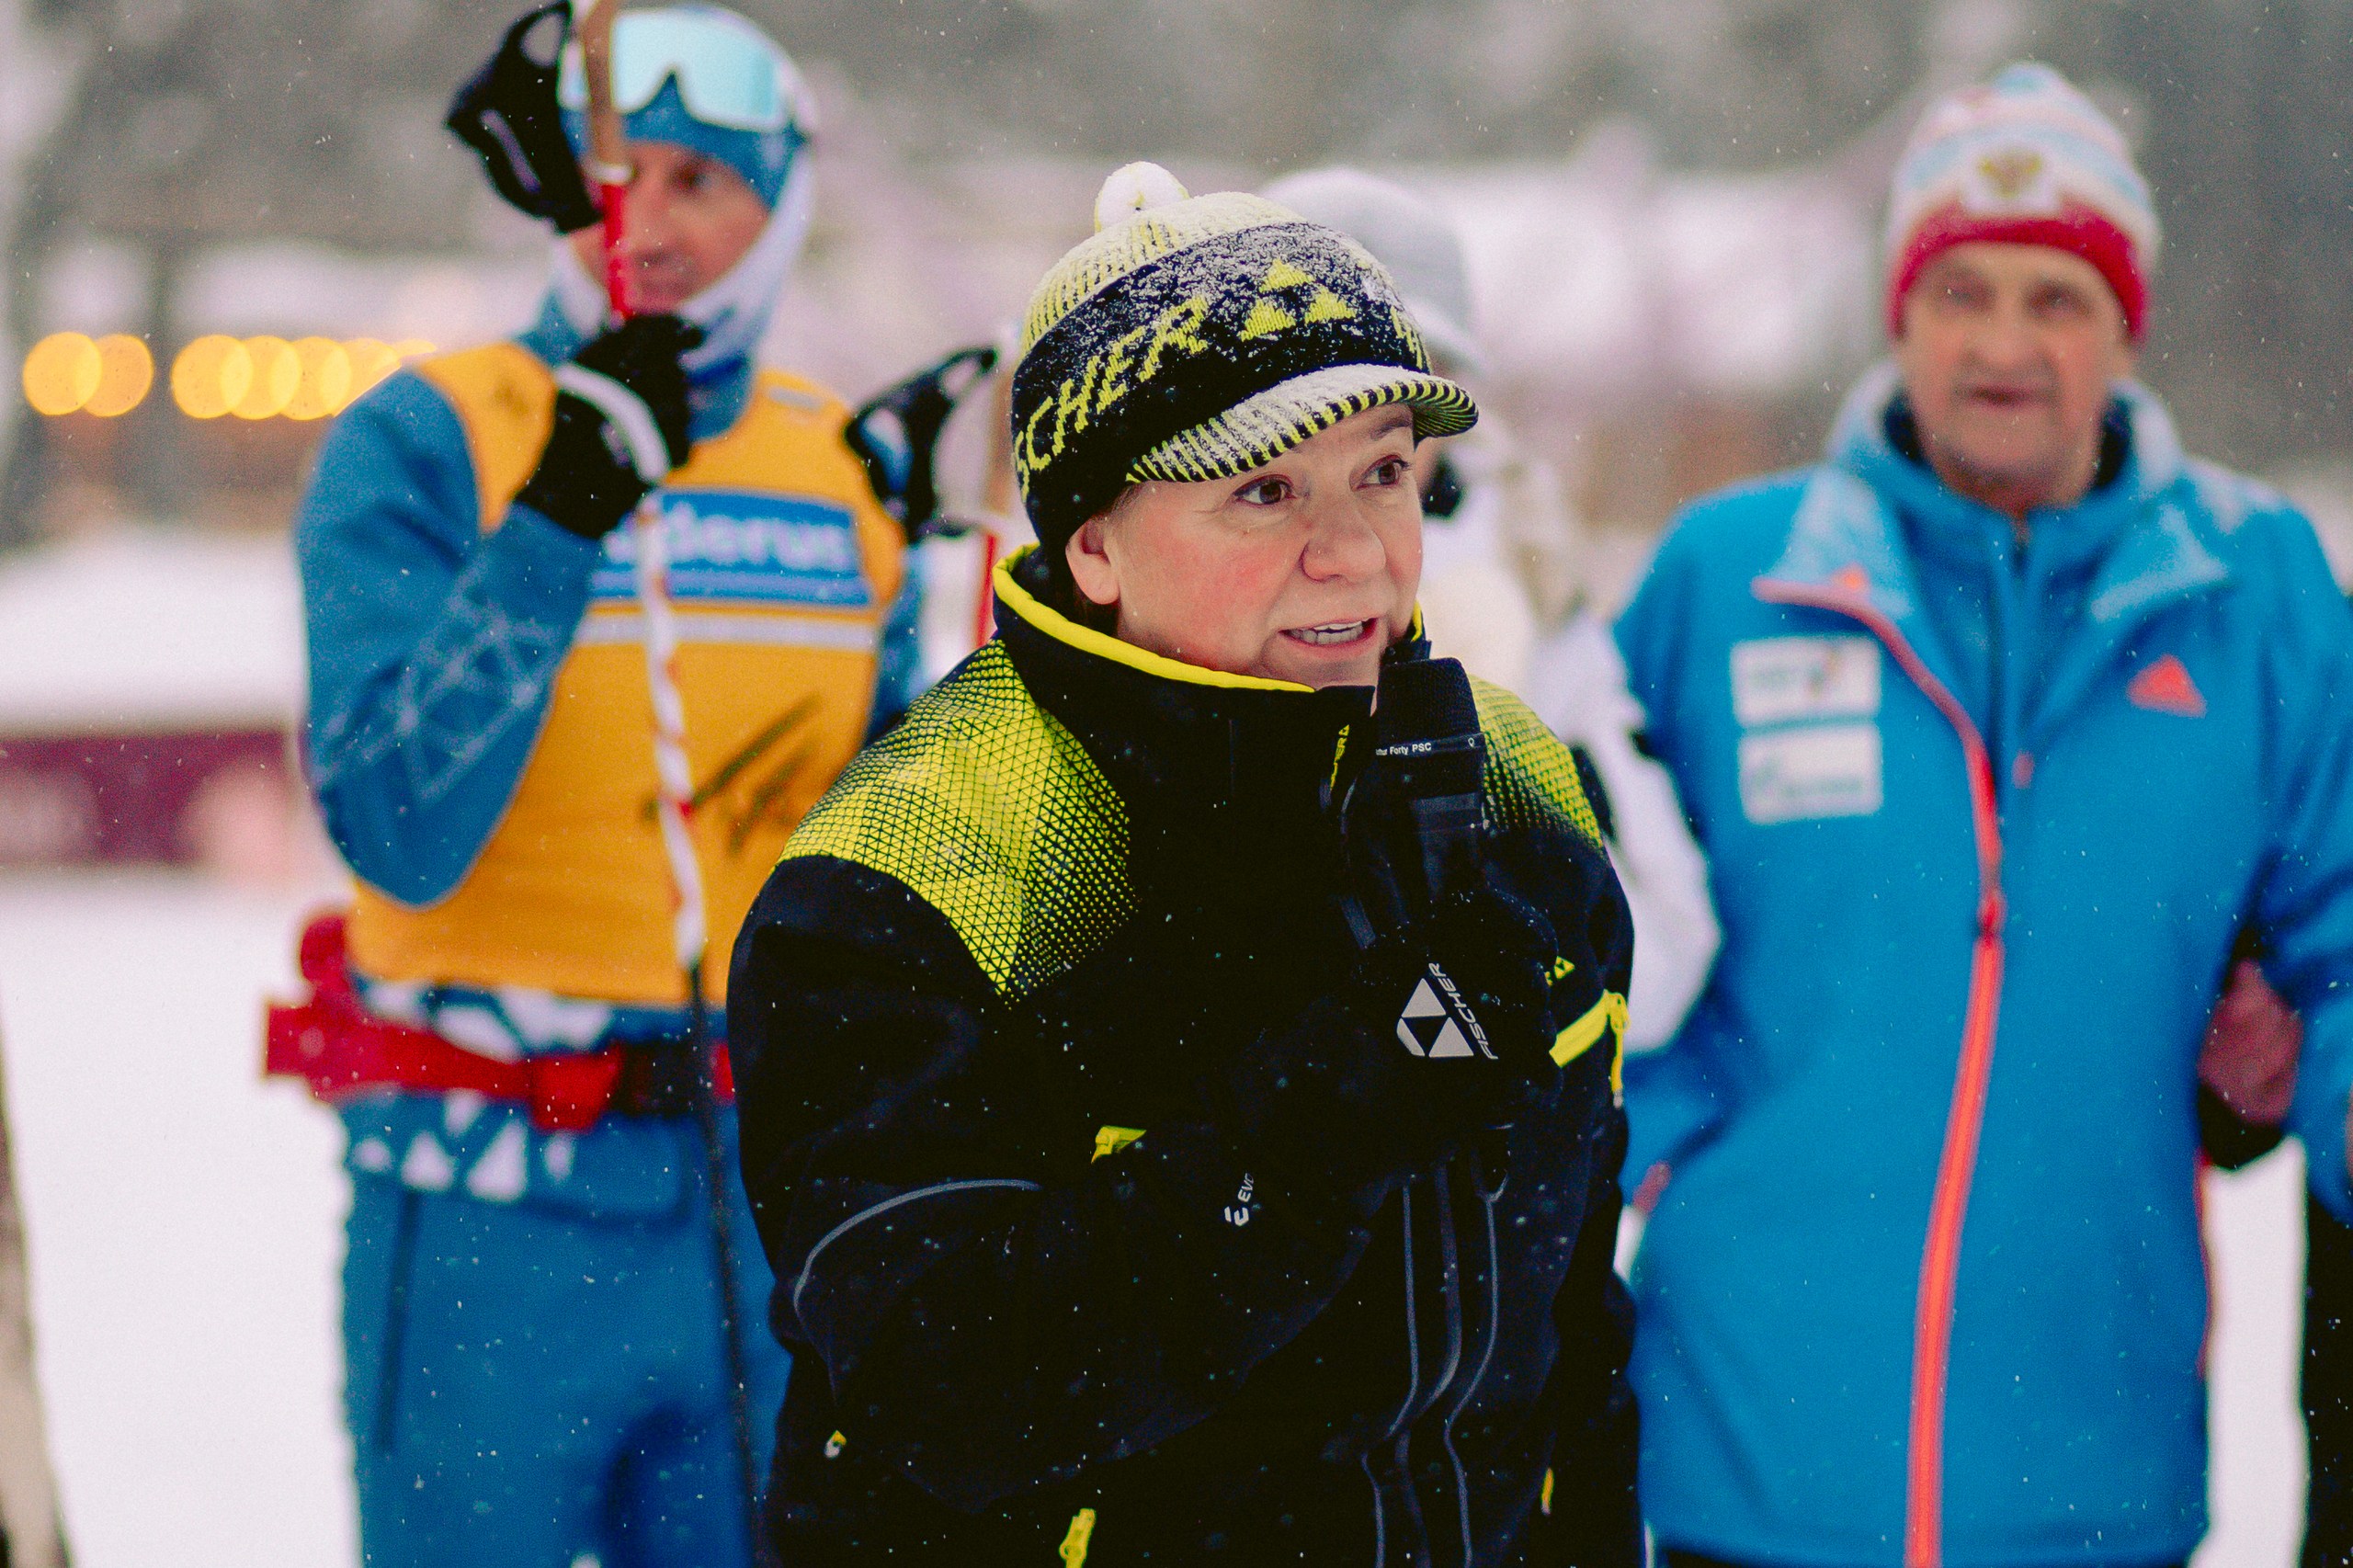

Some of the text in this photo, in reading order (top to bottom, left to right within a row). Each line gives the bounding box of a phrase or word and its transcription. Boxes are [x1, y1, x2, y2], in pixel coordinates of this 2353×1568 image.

[1389, 745, 1408, 756] Forty
[1412, 742, 1432, 753] PSC
[1427, 962, 1499, 1060] FISCHER
